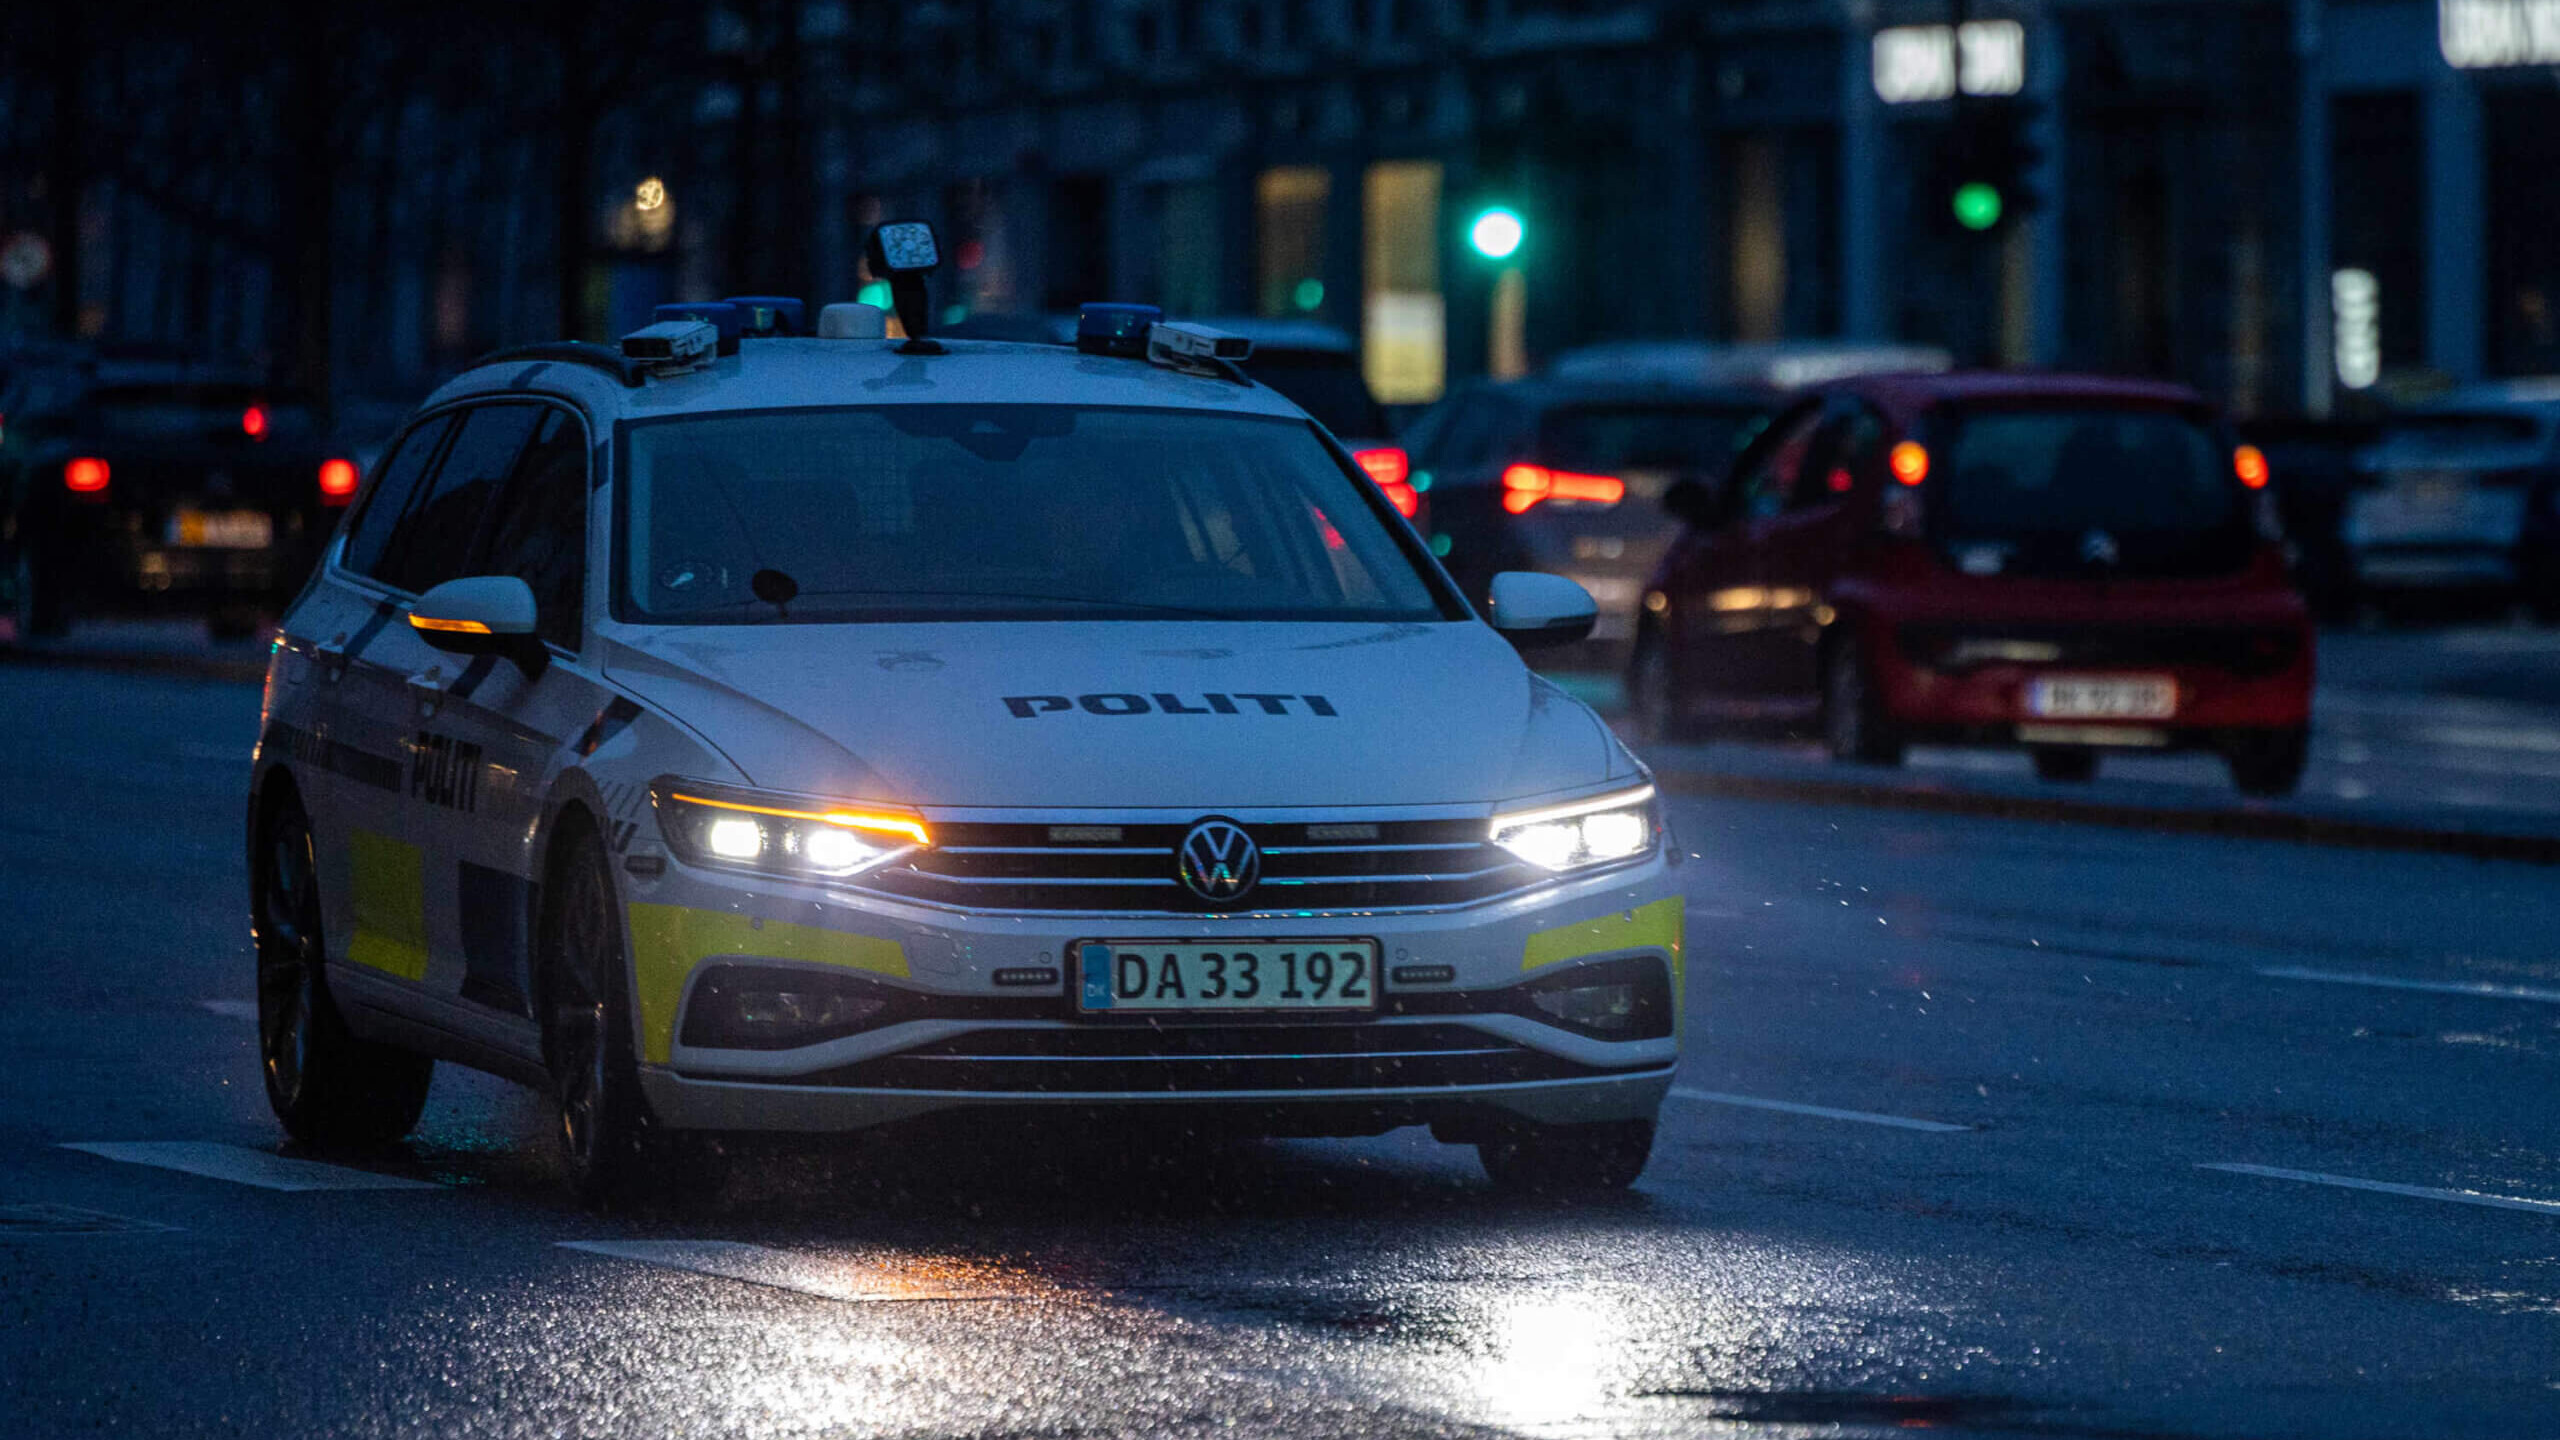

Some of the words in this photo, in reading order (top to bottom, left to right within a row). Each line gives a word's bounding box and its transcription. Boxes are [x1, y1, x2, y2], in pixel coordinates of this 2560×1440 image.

[1001, 693, 1339, 718] POLITI
[411, 731, 482, 813] POLITI
[1118, 953, 1185, 999] DA
[1201, 952, 1260, 999] 33
[1280, 951, 1366, 1000] 192
